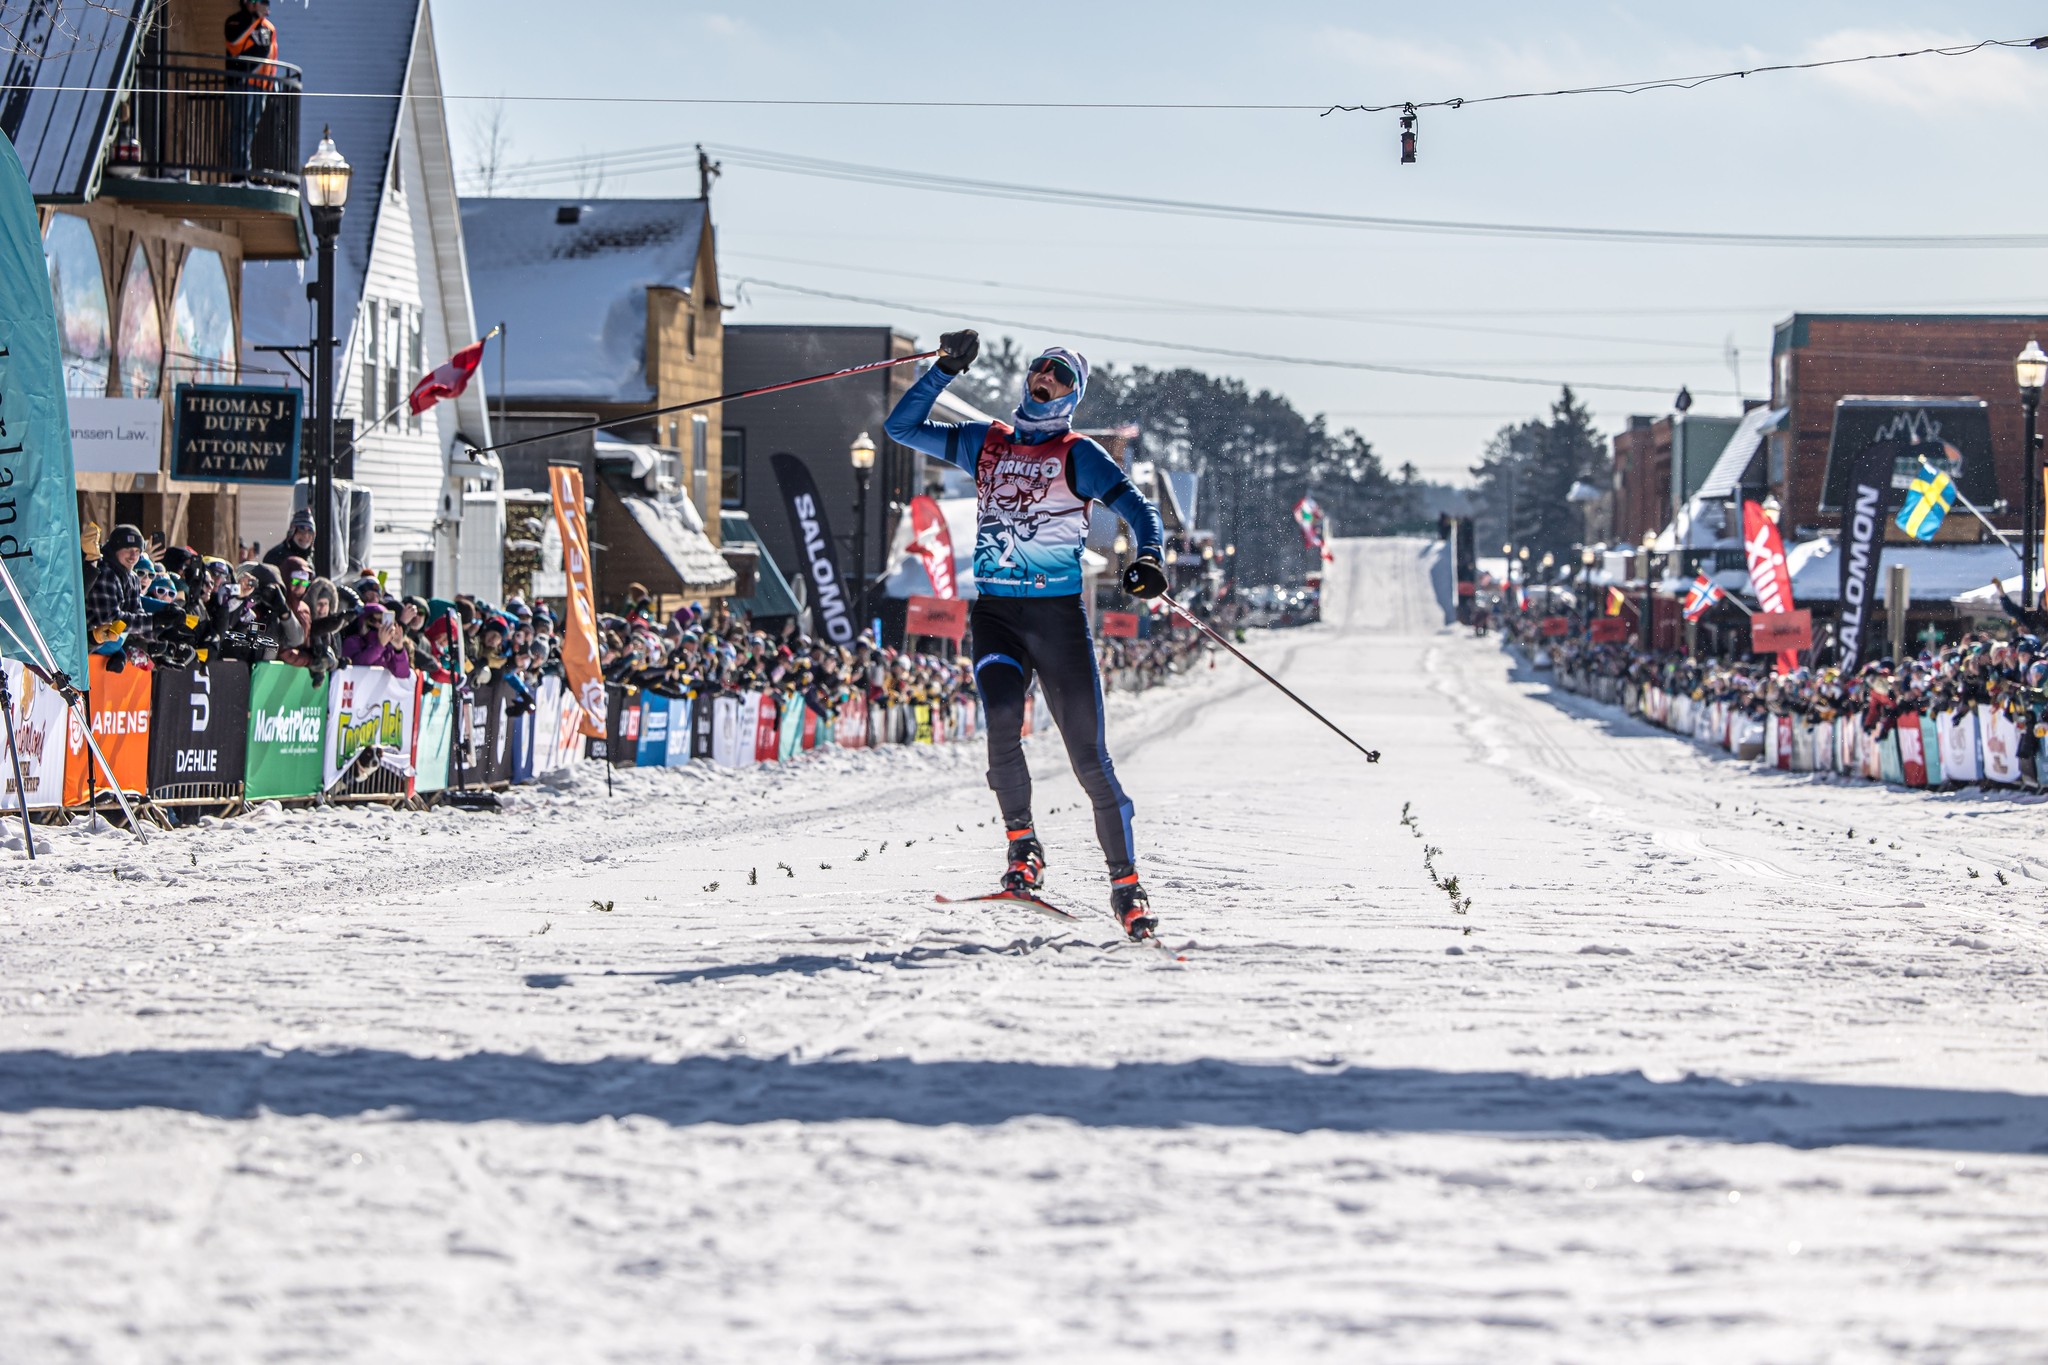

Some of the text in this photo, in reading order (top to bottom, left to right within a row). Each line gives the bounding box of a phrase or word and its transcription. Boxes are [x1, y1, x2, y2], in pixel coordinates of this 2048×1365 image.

[186, 397, 291, 420] THOMAS J.
[204, 415, 270, 432] DUFFY
[69, 428, 113, 441] anssen
[186, 439, 286, 457] ATTORNEY
[201, 456, 269, 471] AT LAW
[994, 459, 1041, 477] BIRKIE
[1046, 465, 1053, 475] 4
[996, 531, 1017, 568] 2
[794, 493, 856, 649] SALOMO
[1840, 484, 1880, 674] SALOMON
[92, 710, 148, 735] ARIENS
[254, 705, 321, 743] MarketPlace
